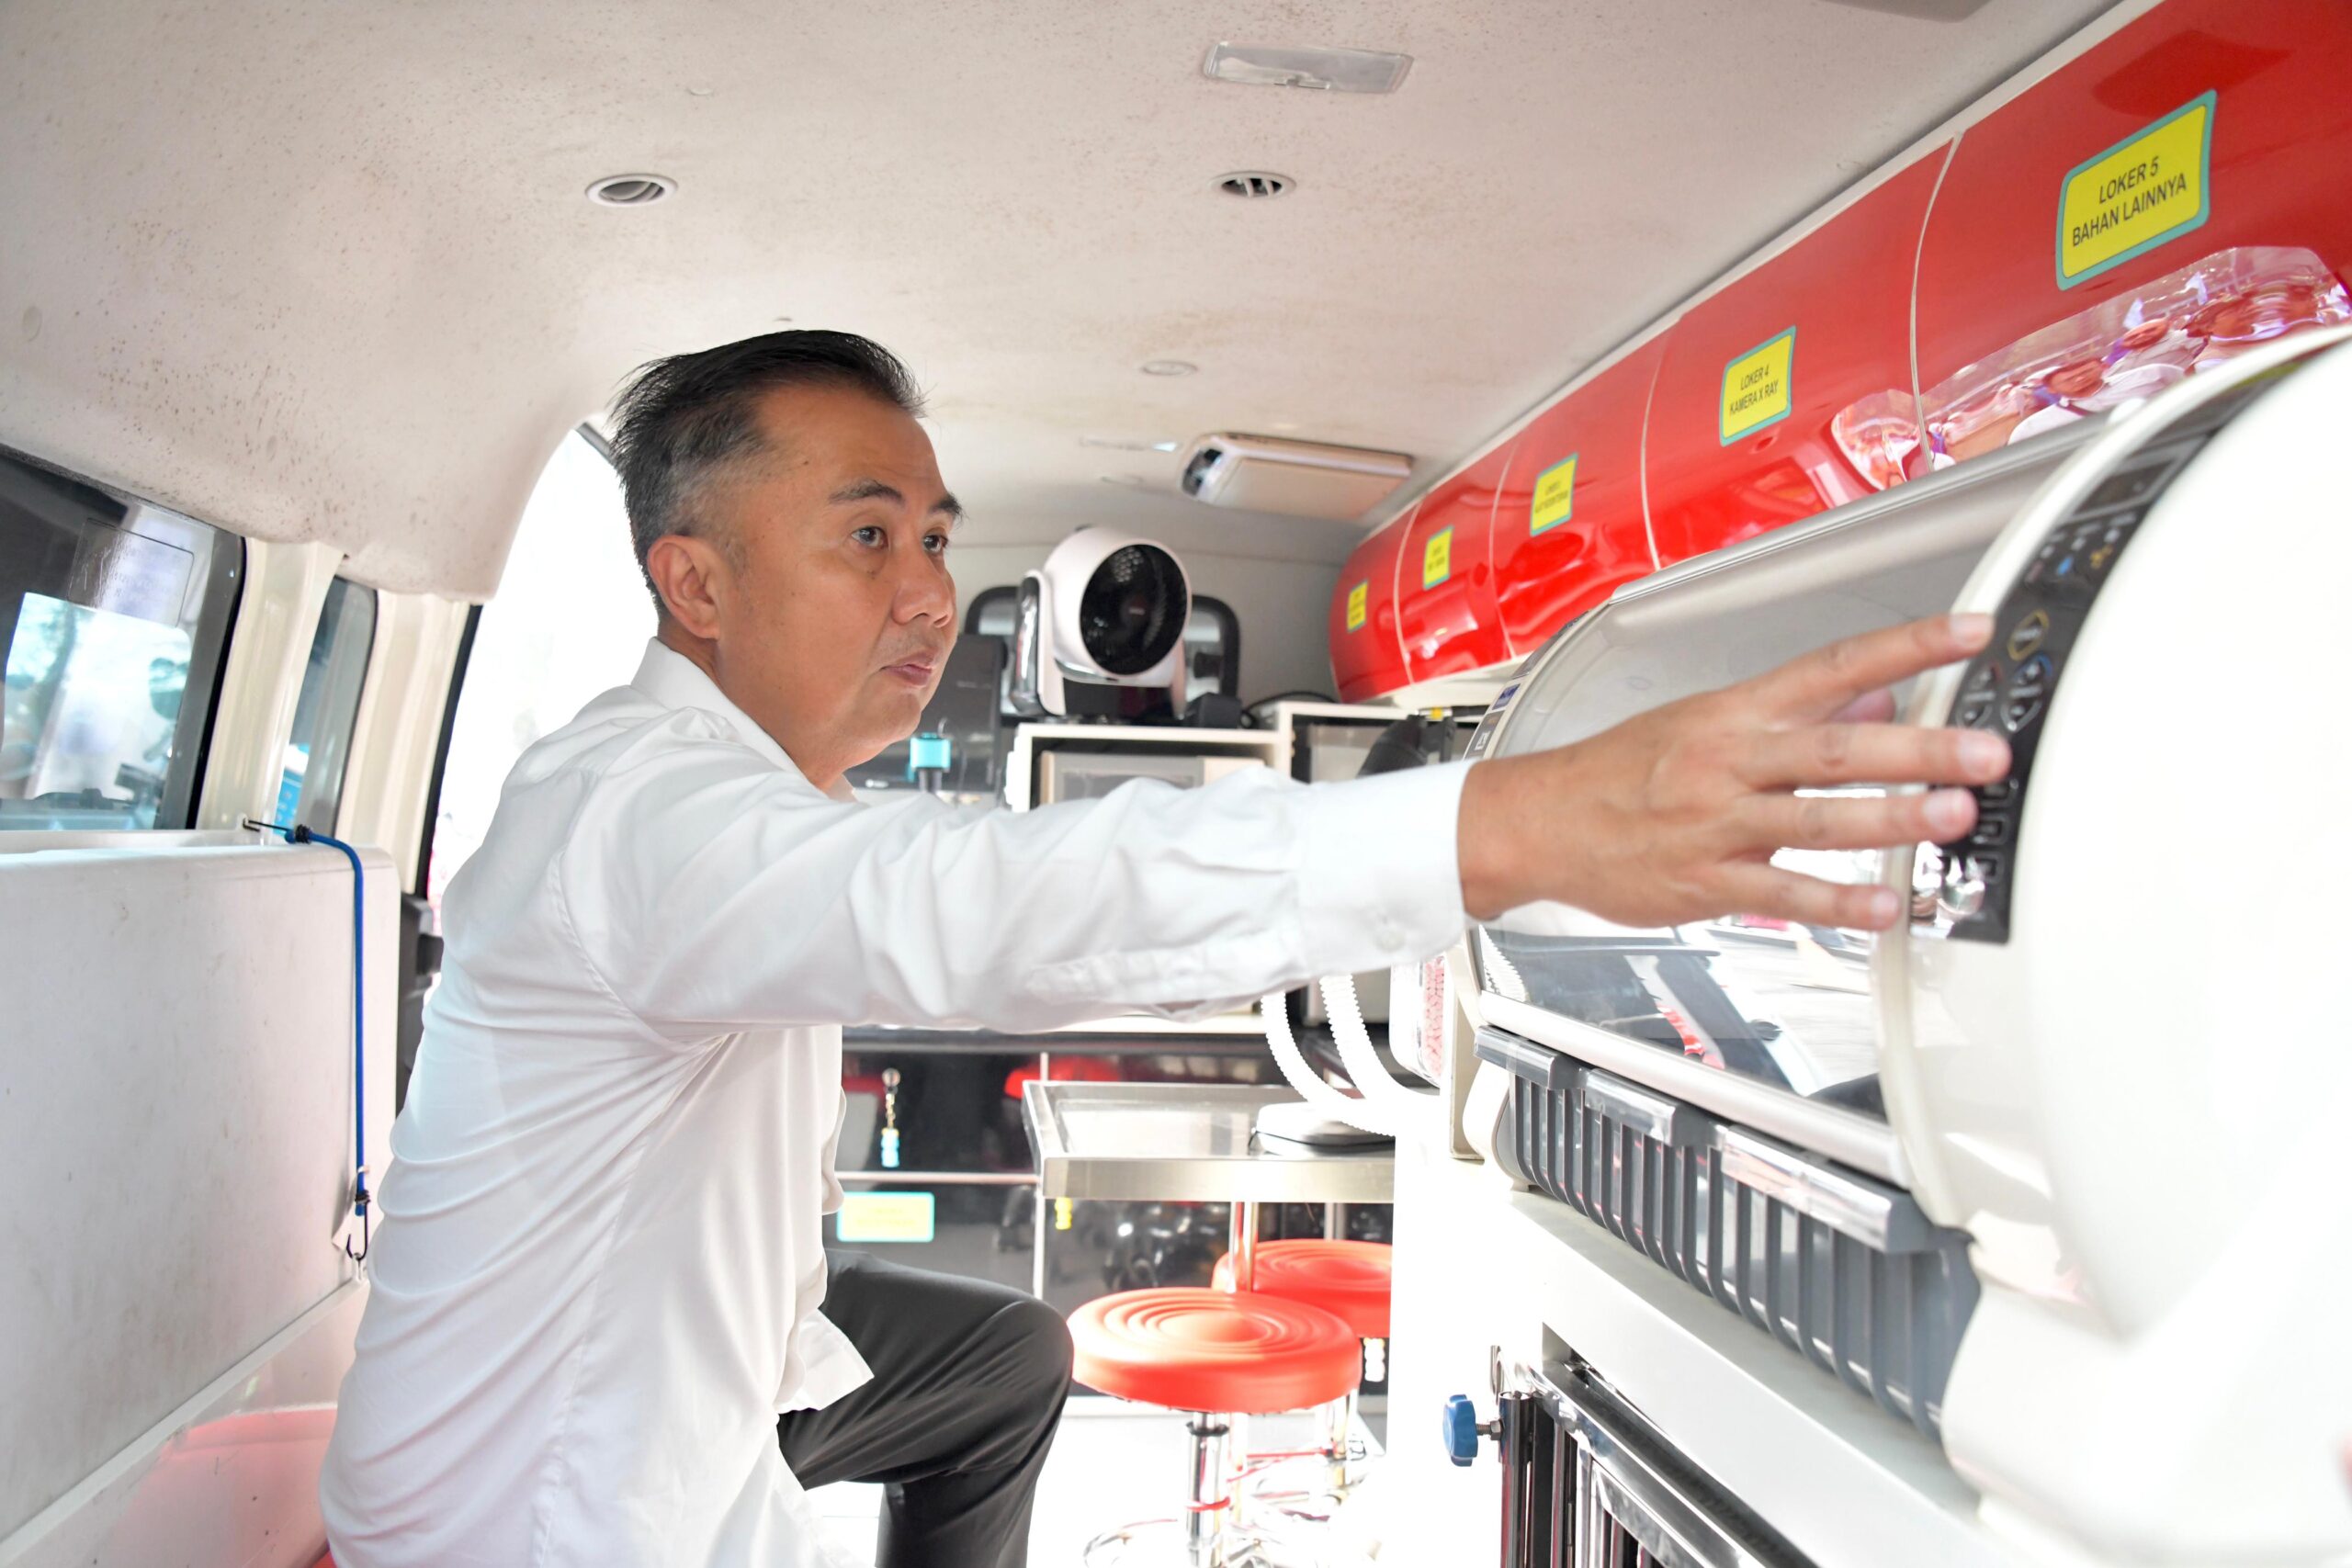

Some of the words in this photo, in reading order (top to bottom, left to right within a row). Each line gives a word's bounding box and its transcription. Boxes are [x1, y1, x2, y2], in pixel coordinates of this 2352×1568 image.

[2099, 164, 2146, 204] LOKER
[2150, 156, 2159, 176] 5
[2073, 207, 2119, 247] BAHAN
[2123, 173, 2187, 220] LAINNYA
[1740, 367, 1764, 390] LOKER
[1765, 379, 1779, 397] RAY
